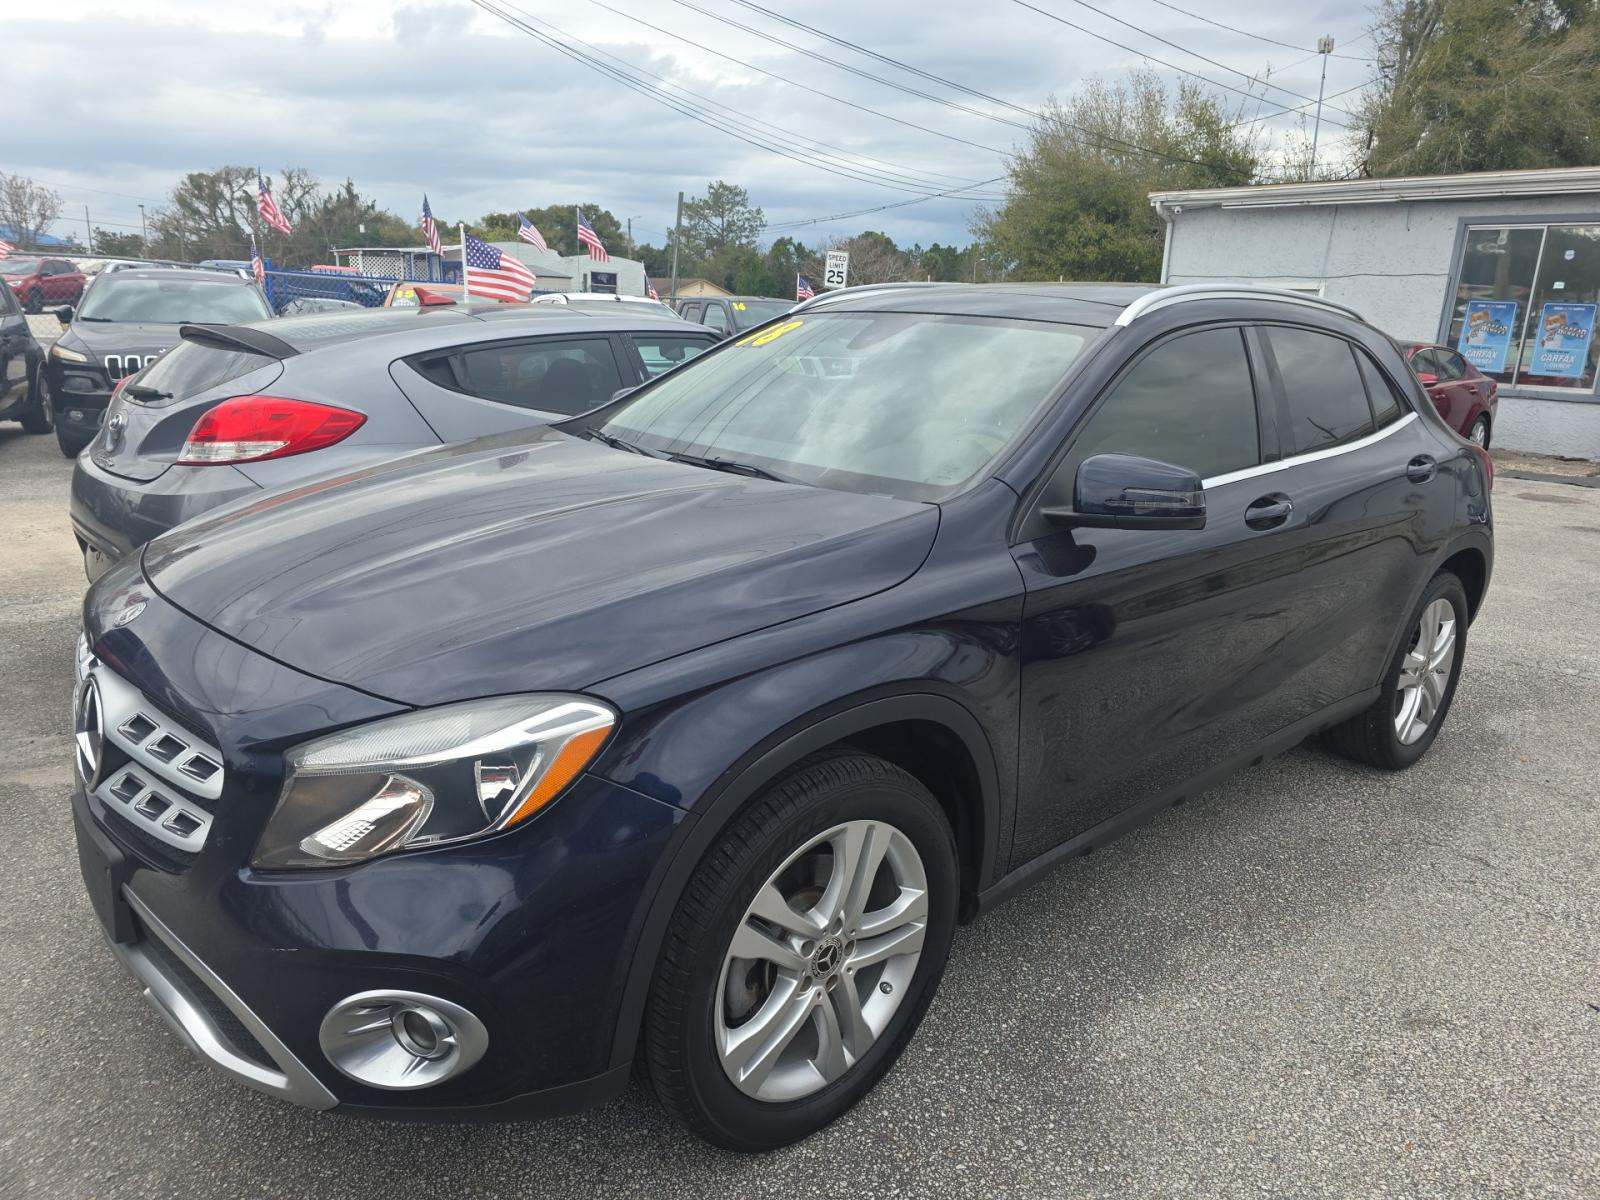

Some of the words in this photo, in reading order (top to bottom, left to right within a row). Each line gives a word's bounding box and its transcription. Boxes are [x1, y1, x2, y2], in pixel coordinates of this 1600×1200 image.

[828, 254, 847, 262] SPEED
[827, 269, 844, 285] 25
[1465, 349, 1498, 360] CARFAX
[1540, 353, 1576, 363] CARFAX
